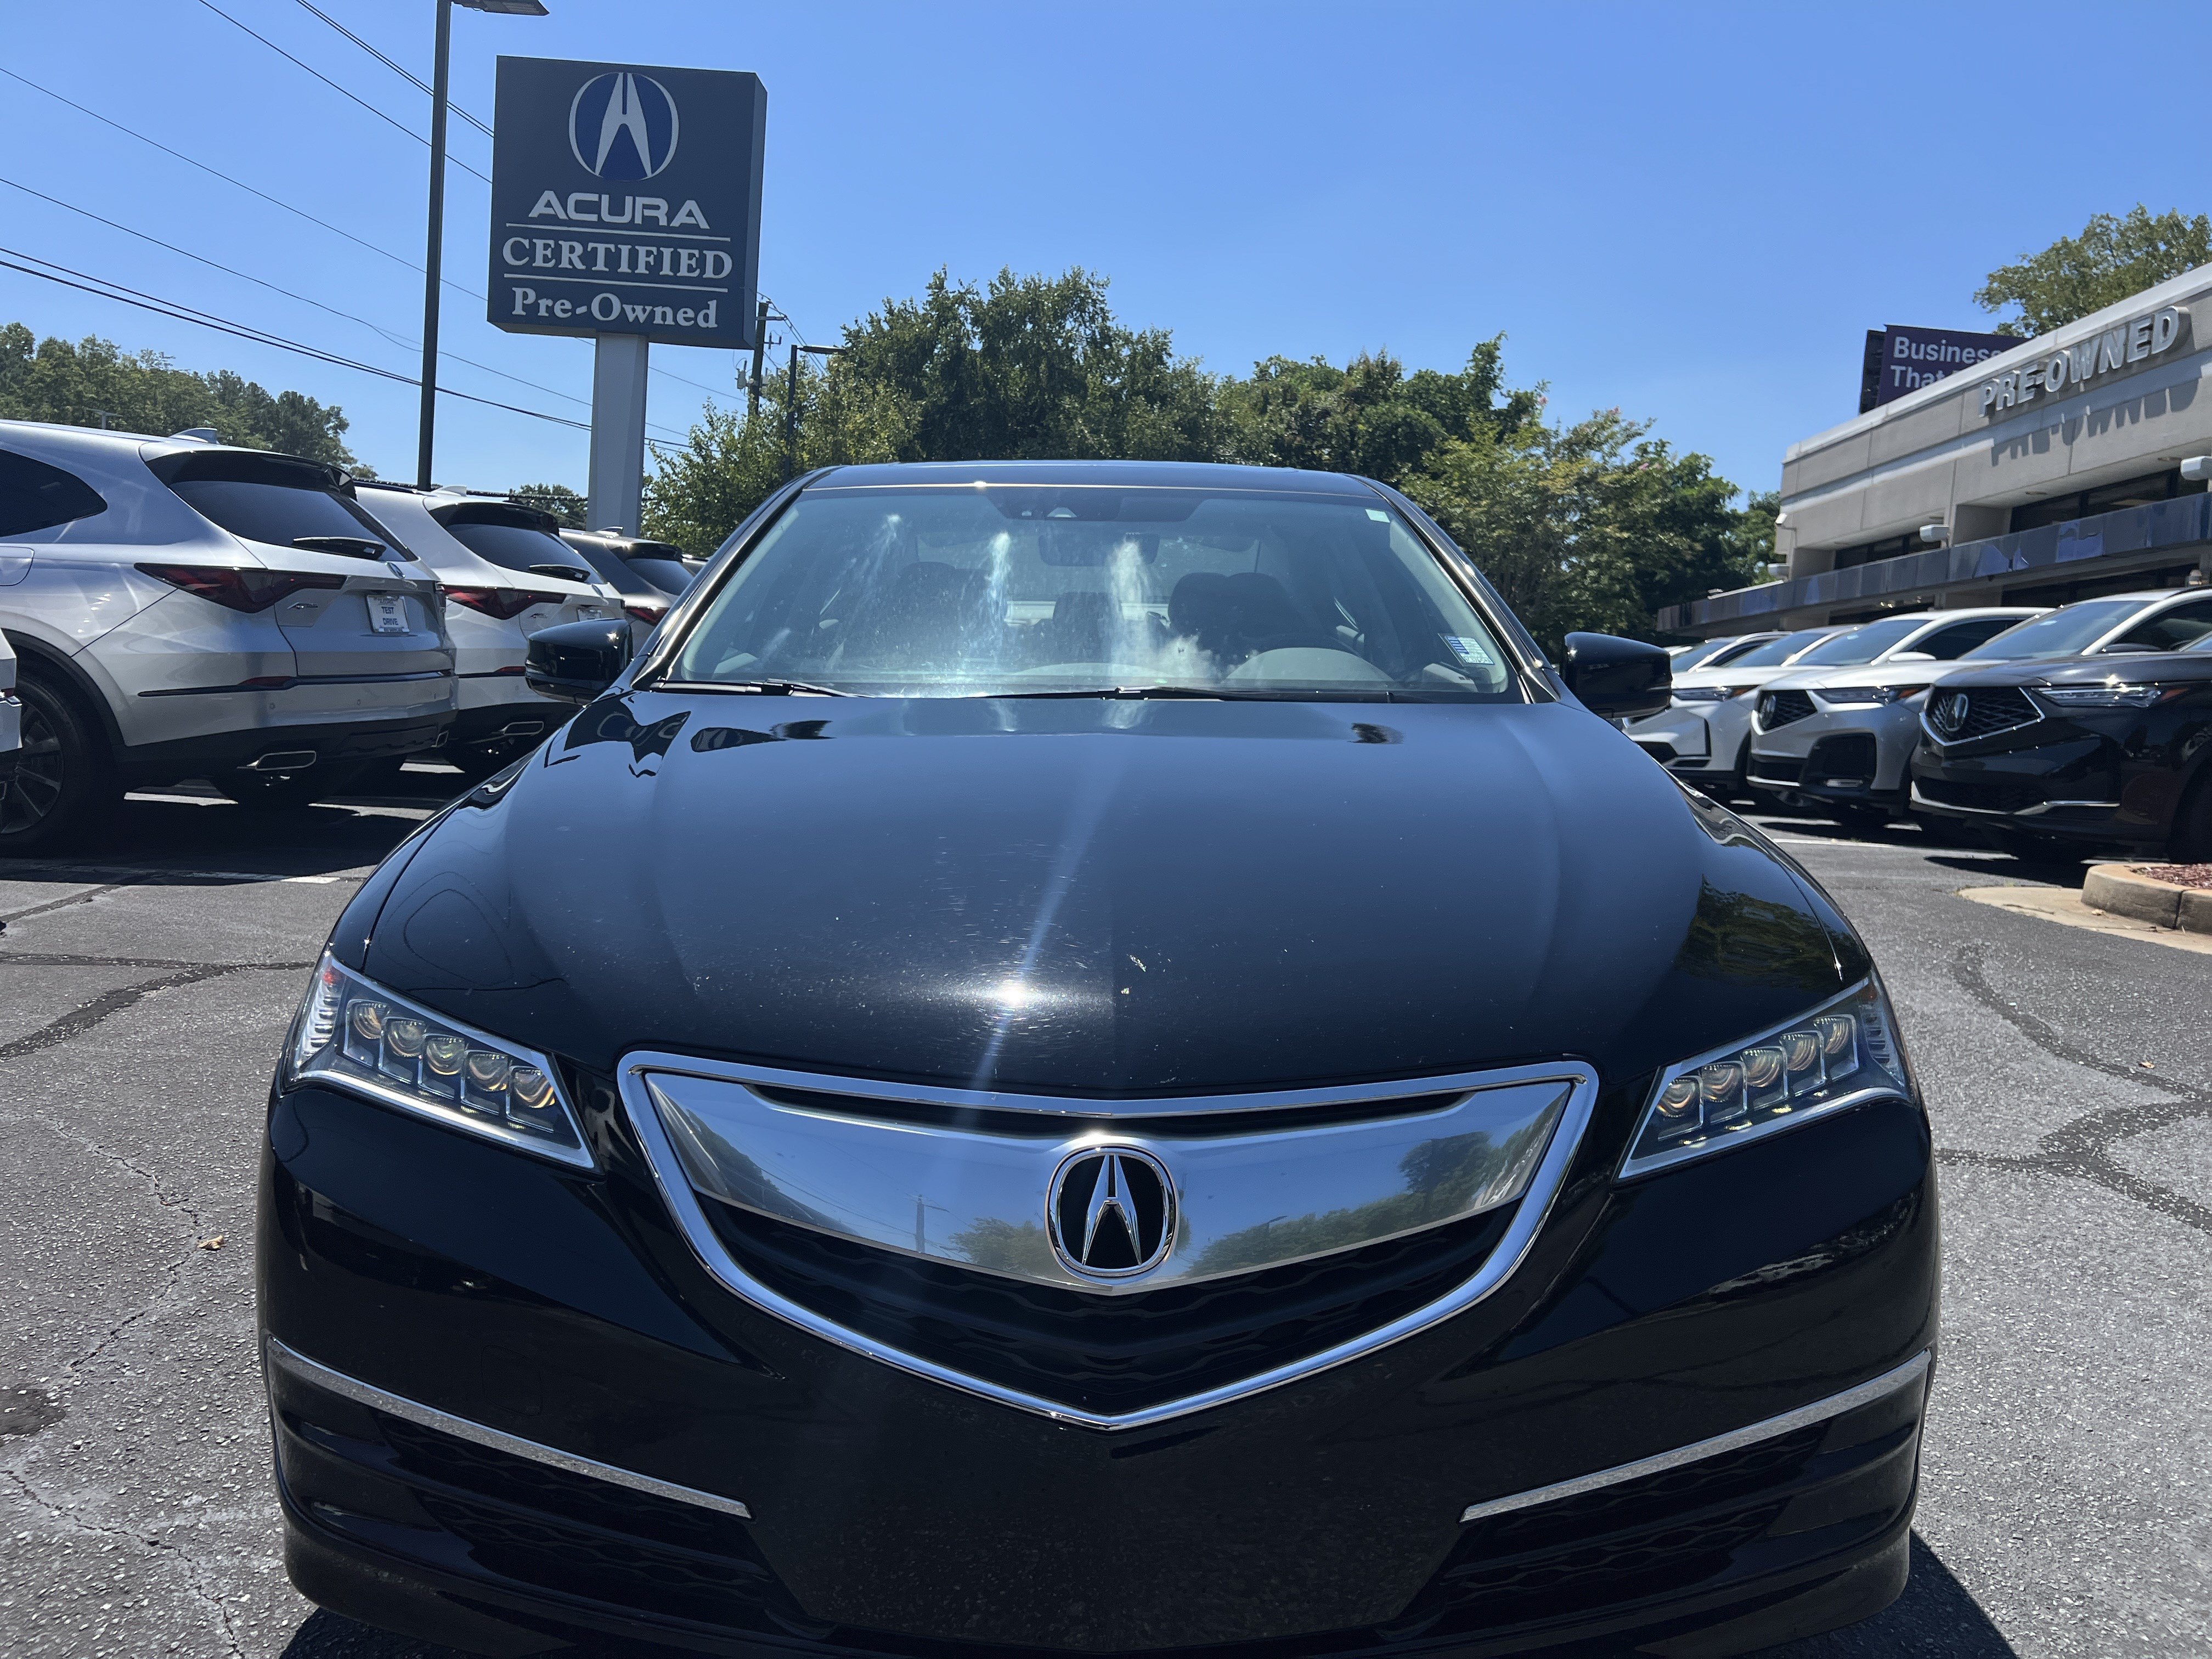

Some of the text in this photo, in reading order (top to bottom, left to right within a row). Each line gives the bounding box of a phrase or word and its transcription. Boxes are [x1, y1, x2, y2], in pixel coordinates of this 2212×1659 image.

[528, 190, 710, 229] ACURA
[503, 237, 732, 279] CERTIFIED
[512, 287, 718, 328] Pre-Owned
[1979, 306, 2180, 417] PRE-OWNED
[381, 606, 394, 614] TEST
